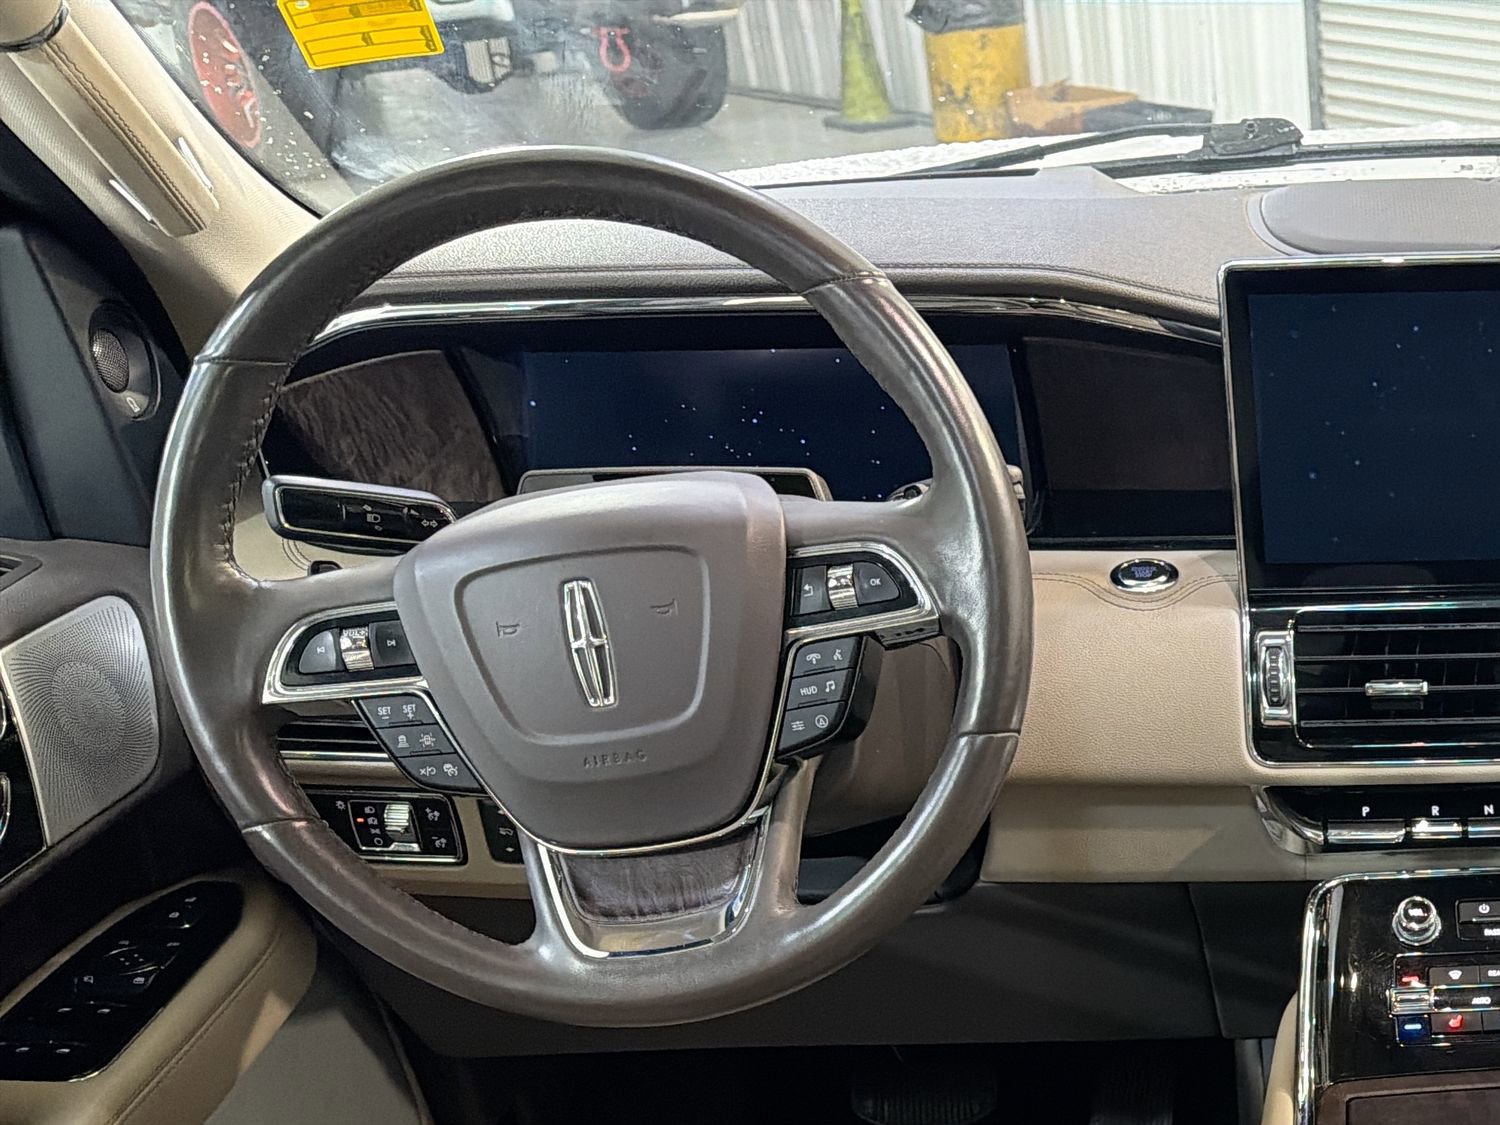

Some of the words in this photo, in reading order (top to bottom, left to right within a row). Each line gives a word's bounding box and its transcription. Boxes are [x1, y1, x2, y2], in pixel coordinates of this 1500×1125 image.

[869, 577, 881, 586] OK
[800, 685, 818, 696] HUD
[378, 706, 391, 716] SET
[402, 704, 416, 714] SET
[1362, 806, 1370, 816] P
[1431, 805, 1439, 816] R
[1484, 804, 1494, 815] N
